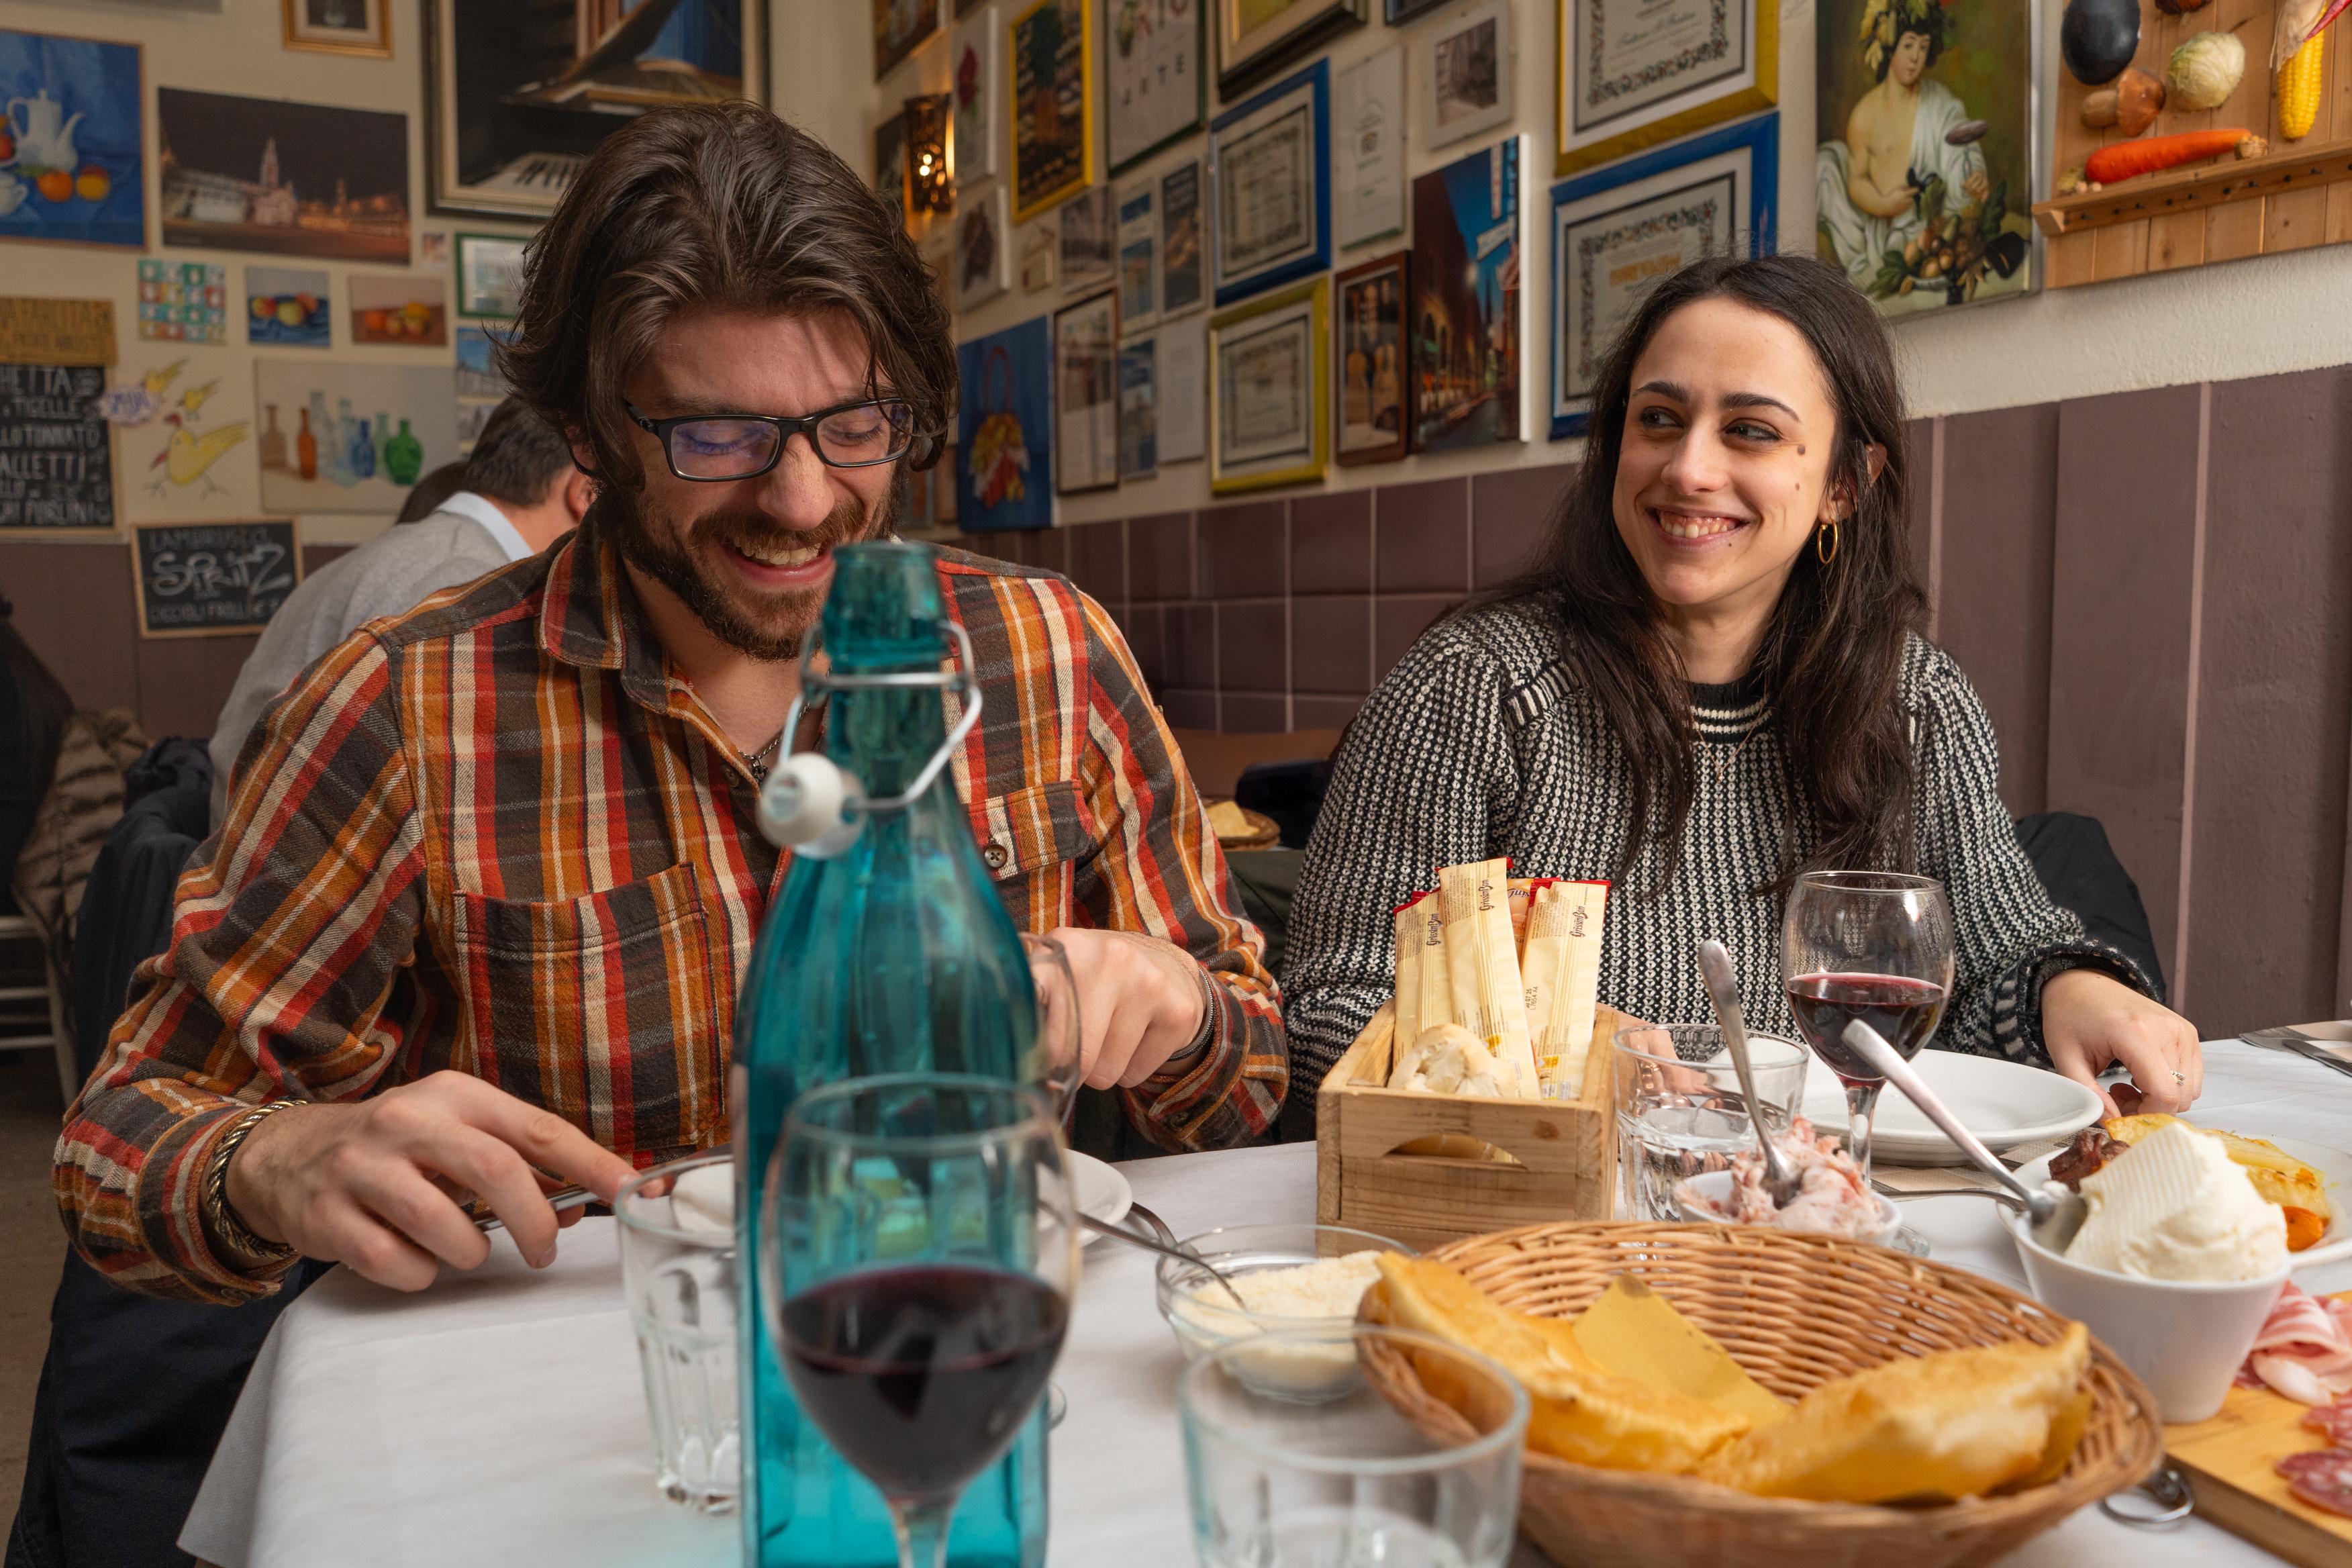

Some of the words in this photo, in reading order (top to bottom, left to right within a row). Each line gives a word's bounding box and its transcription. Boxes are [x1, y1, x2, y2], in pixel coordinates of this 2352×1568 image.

[1478, 879, 1496, 912] GrissinBon
[1426, 913, 1442, 946] GrissinBon
[1569, 905, 1587, 938] GrissinBon
